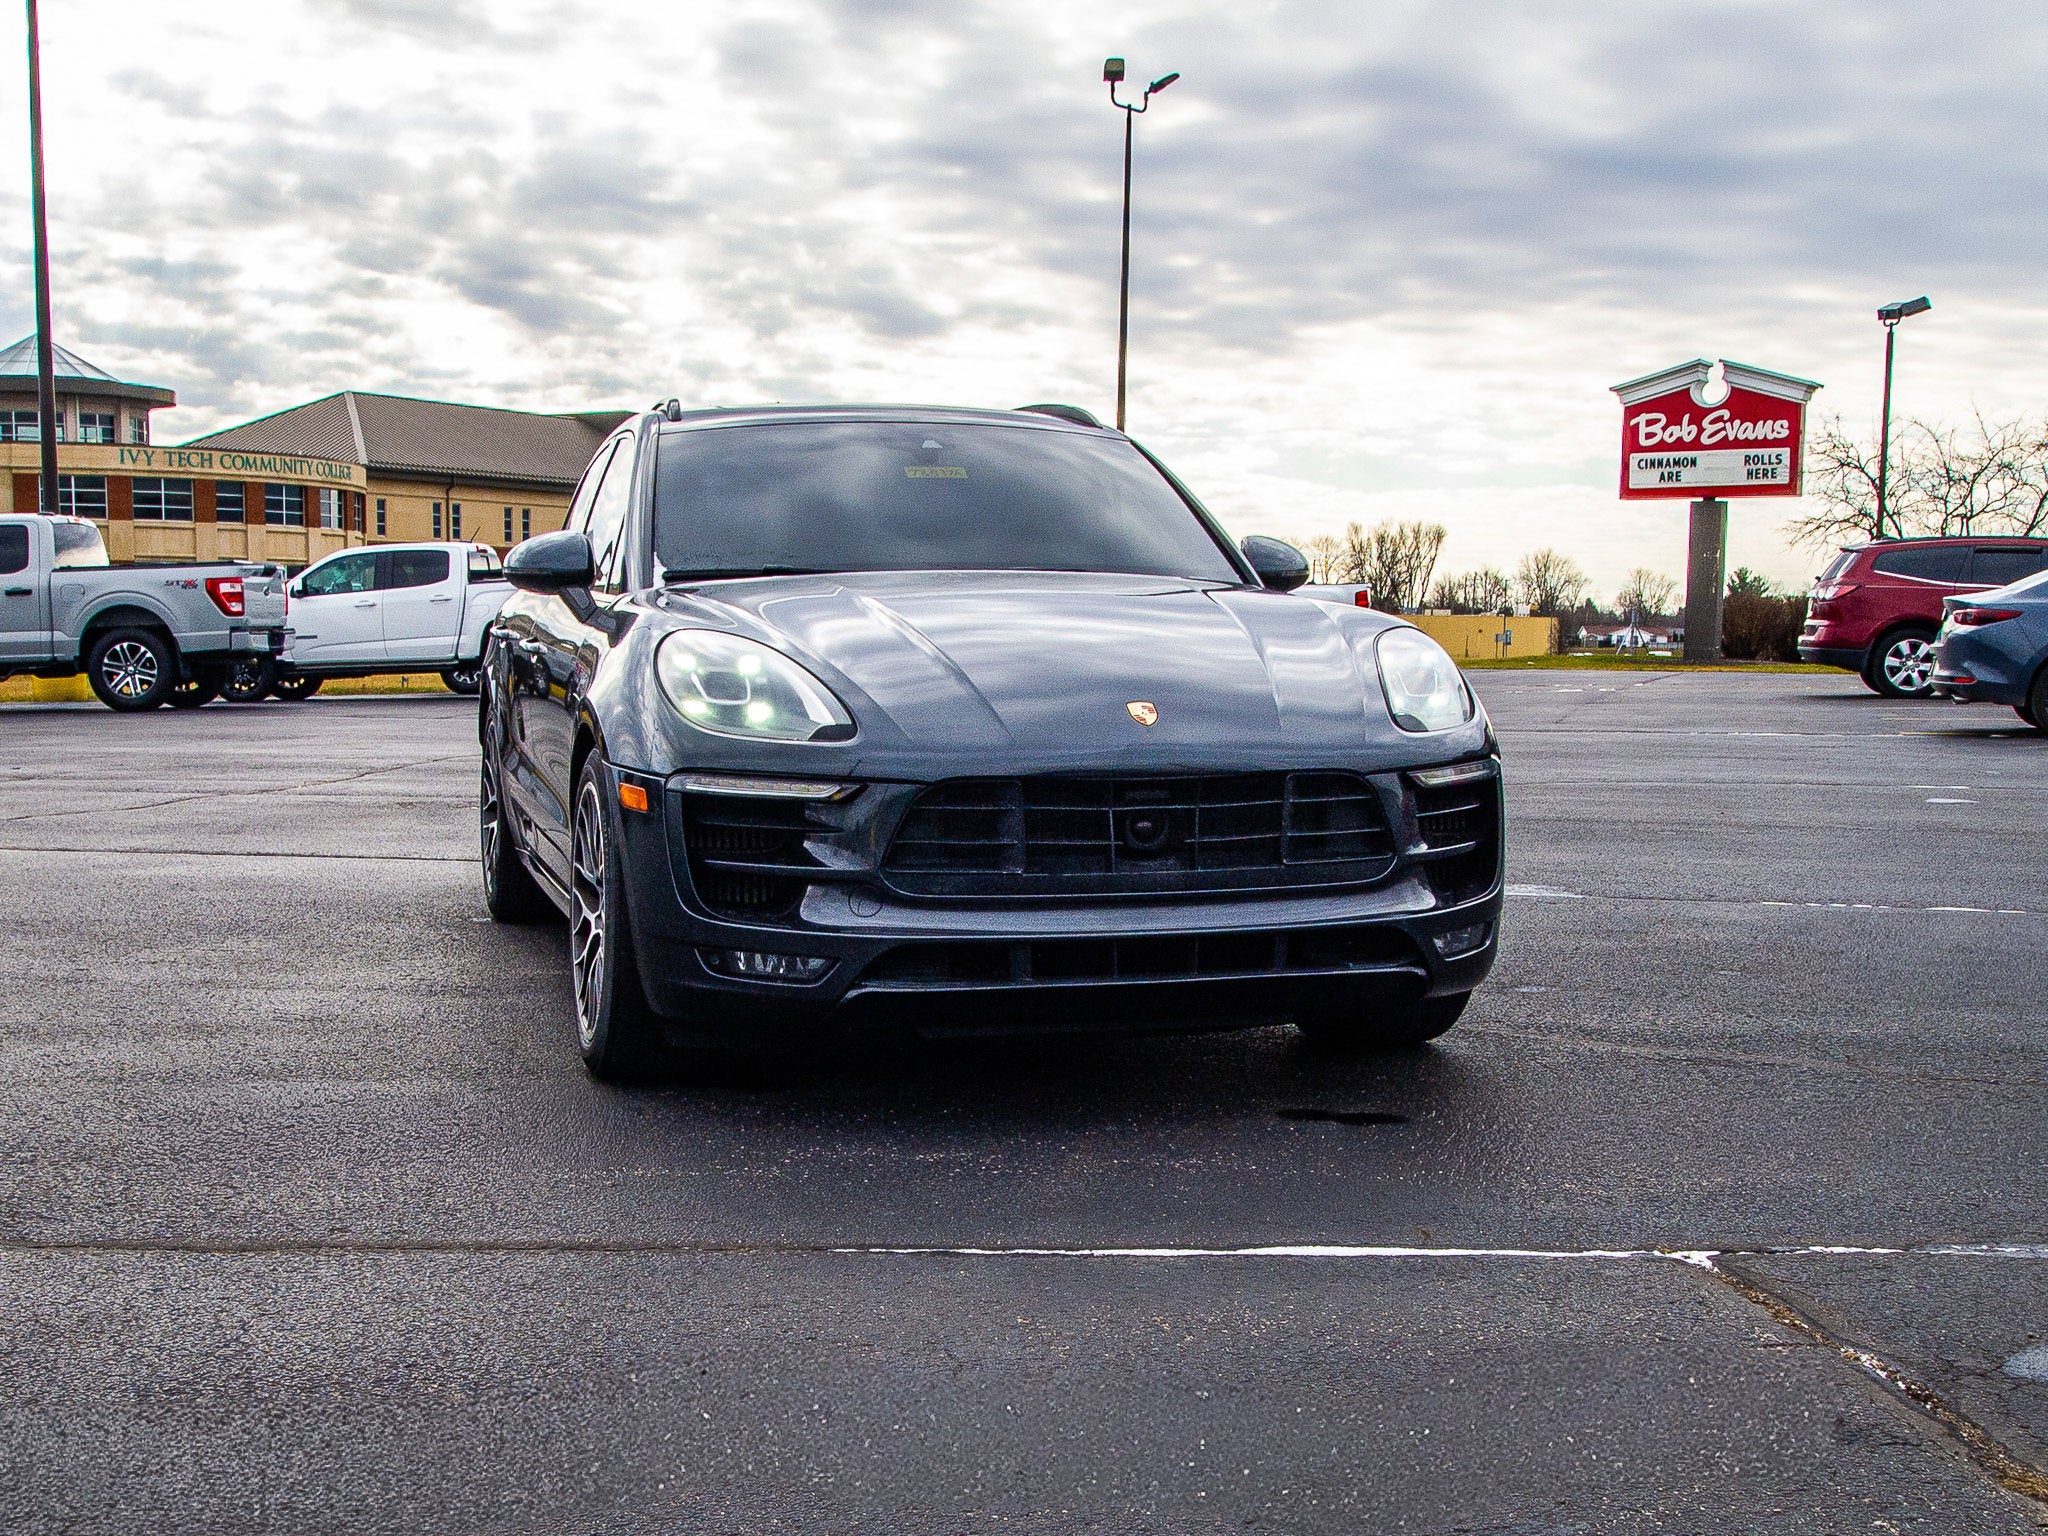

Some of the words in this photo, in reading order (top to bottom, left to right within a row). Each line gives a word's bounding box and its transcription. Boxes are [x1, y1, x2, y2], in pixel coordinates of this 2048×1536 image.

[1630, 412, 1698, 447] Bob
[1700, 409, 1790, 445] Evans
[118, 448, 155, 466] IVY
[164, 450, 213, 469] TECH
[219, 453, 314, 476] COMMUNITY
[315, 461, 352, 480] COLLEGE
[1637, 456, 1698, 470] CINNAMON
[1743, 453, 1784, 467] ROLLS
[1658, 470, 1682, 483] ARE
[1746, 467, 1779, 480] HERE
